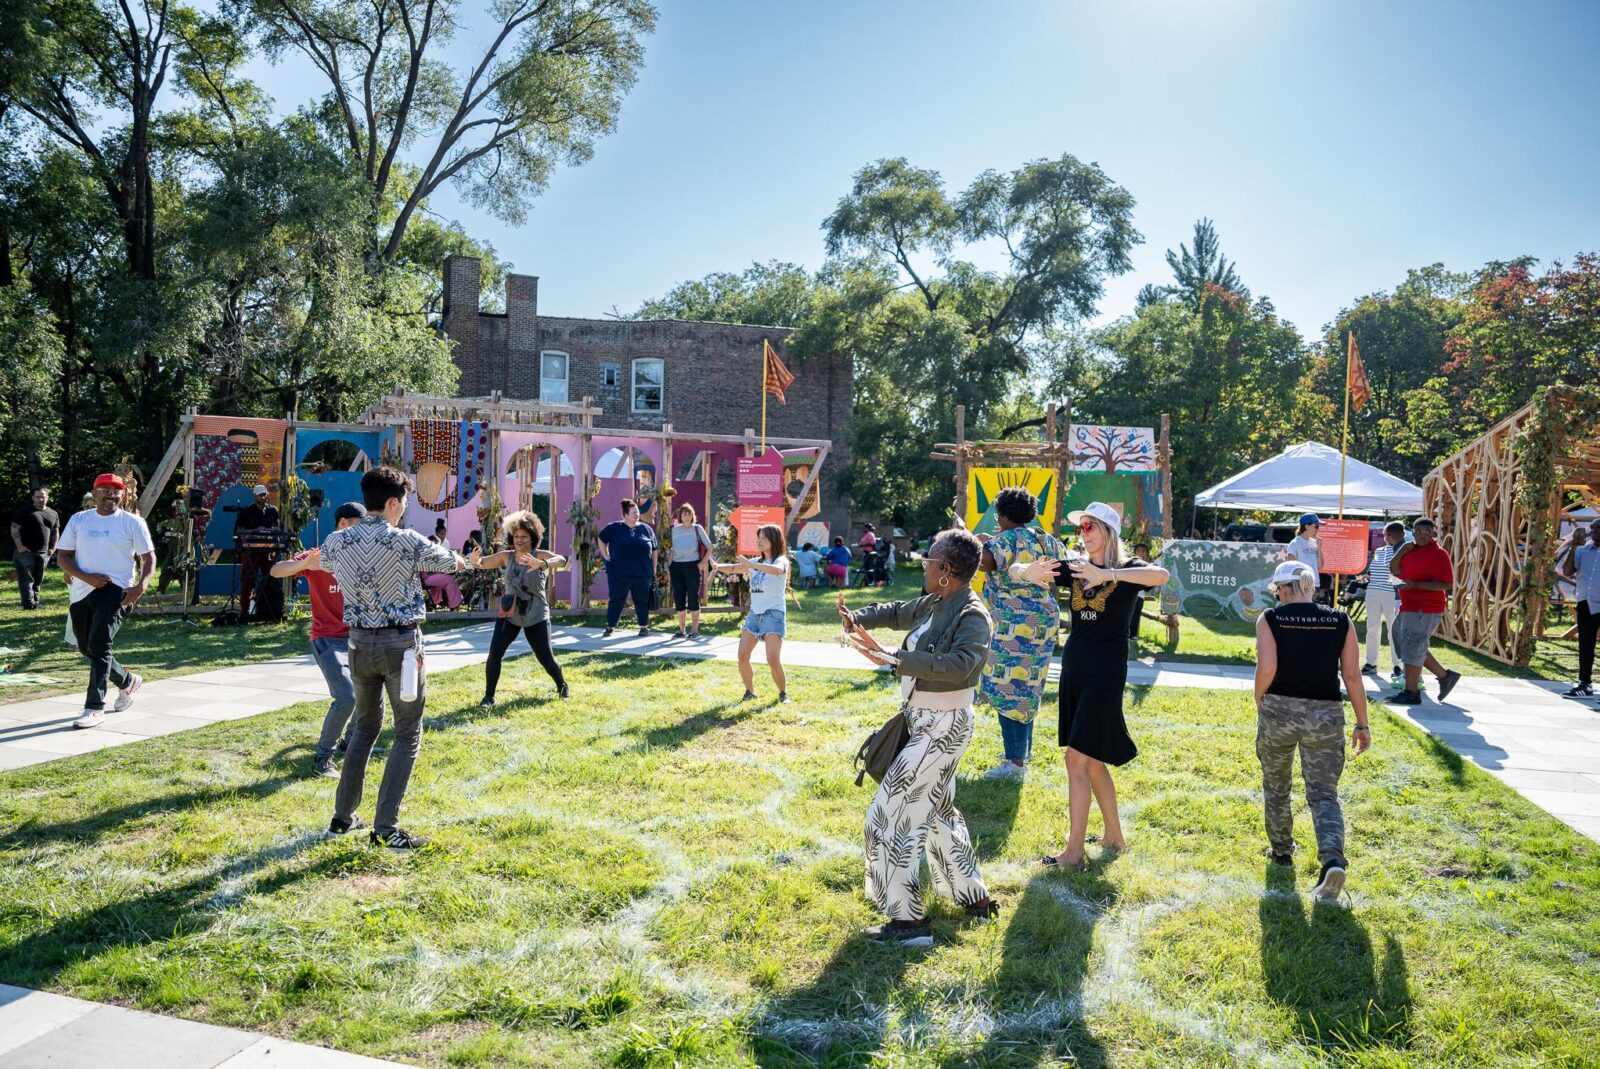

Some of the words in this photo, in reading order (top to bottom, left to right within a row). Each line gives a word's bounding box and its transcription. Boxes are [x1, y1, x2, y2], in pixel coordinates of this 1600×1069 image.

[1189, 562, 1214, 573] SLUM
[1191, 574, 1237, 586] BUSTERS
[1080, 610, 1097, 621] 808
